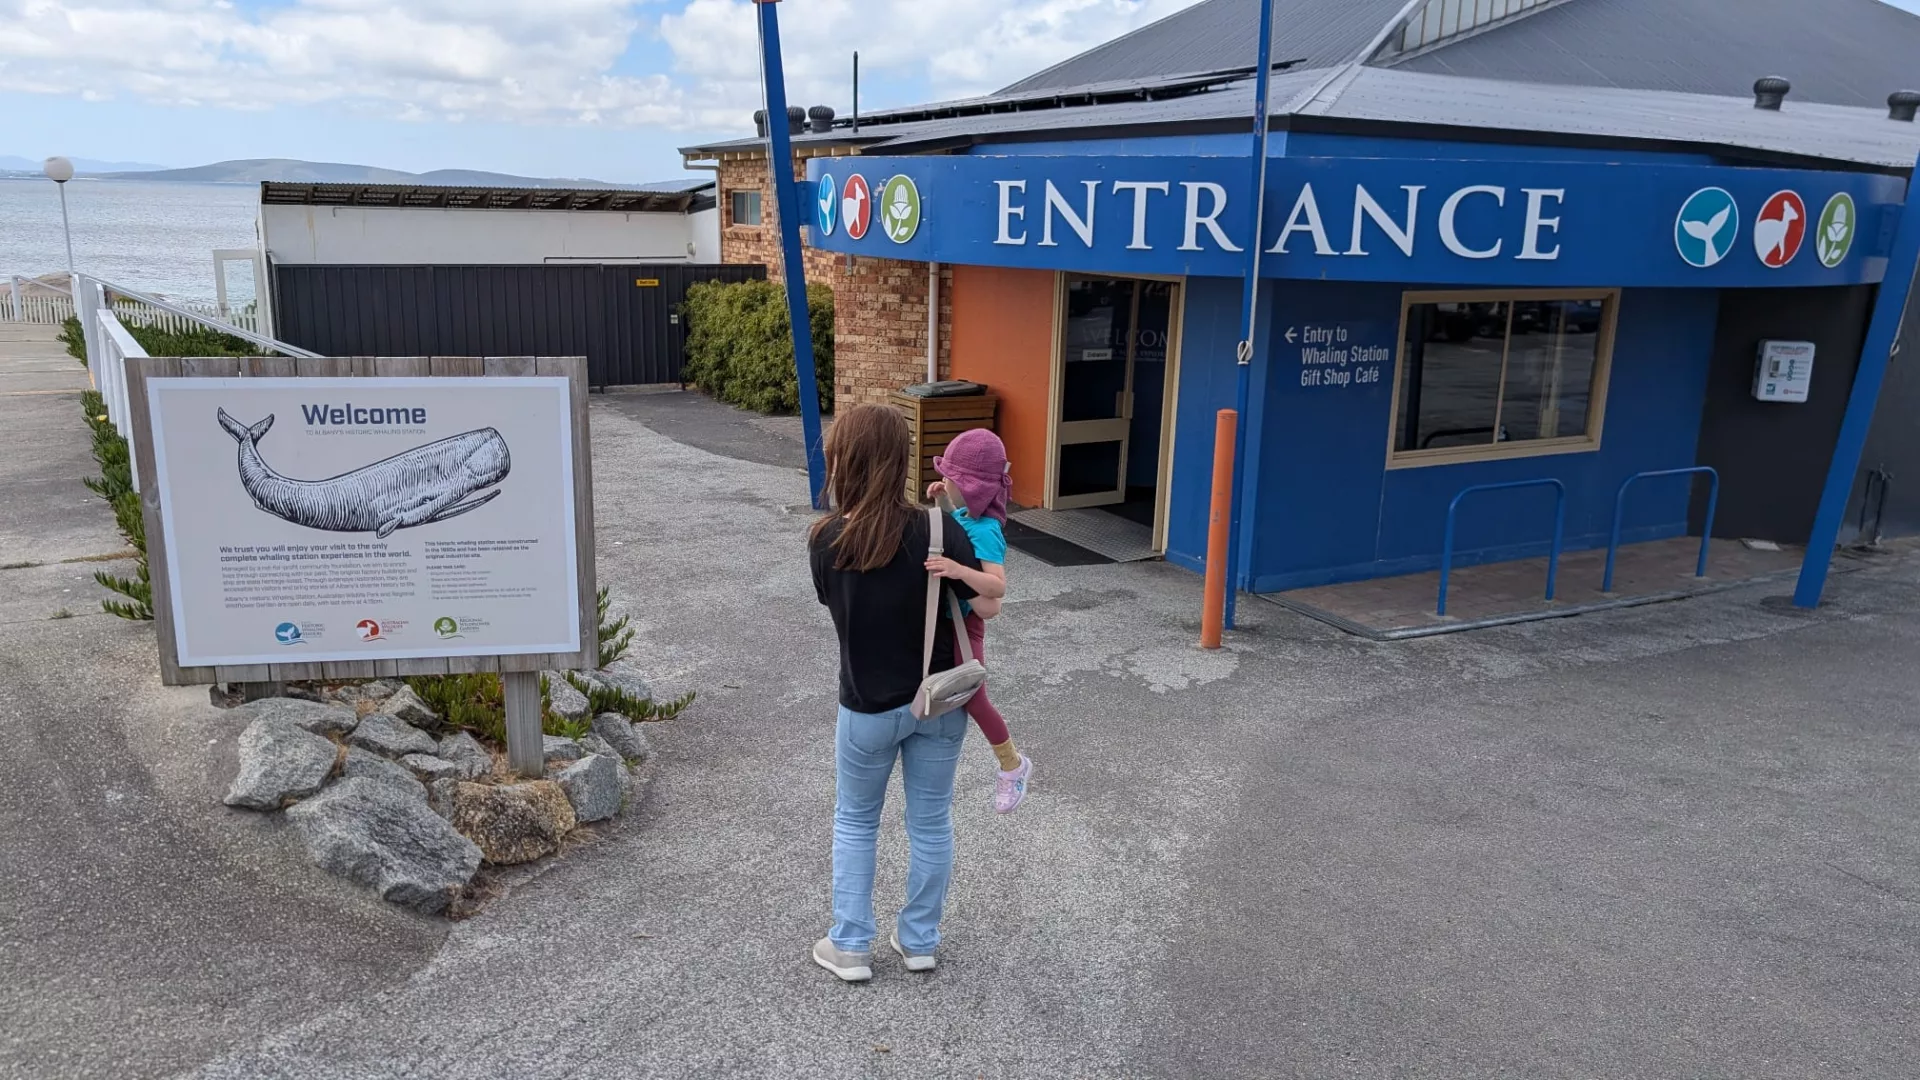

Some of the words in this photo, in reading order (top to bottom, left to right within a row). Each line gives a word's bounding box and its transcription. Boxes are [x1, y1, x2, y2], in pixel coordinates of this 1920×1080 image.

[992, 179, 1565, 261] ENTRANCE
[1304, 326, 1333, 346] Entry
[1337, 326, 1347, 342] to
[1302, 347, 1348, 367] Whaling
[1350, 345, 1389, 362] Station
[1301, 369, 1321, 386] Gift
[1324, 368, 1350, 388] Shop
[1356, 366, 1379, 383] Café
[301, 403, 426, 425] Welcome
[221, 555, 258, 563] complete
[258, 554, 290, 562] whaling
[320, 552, 363, 560] experience
[371, 543, 388, 551] only
